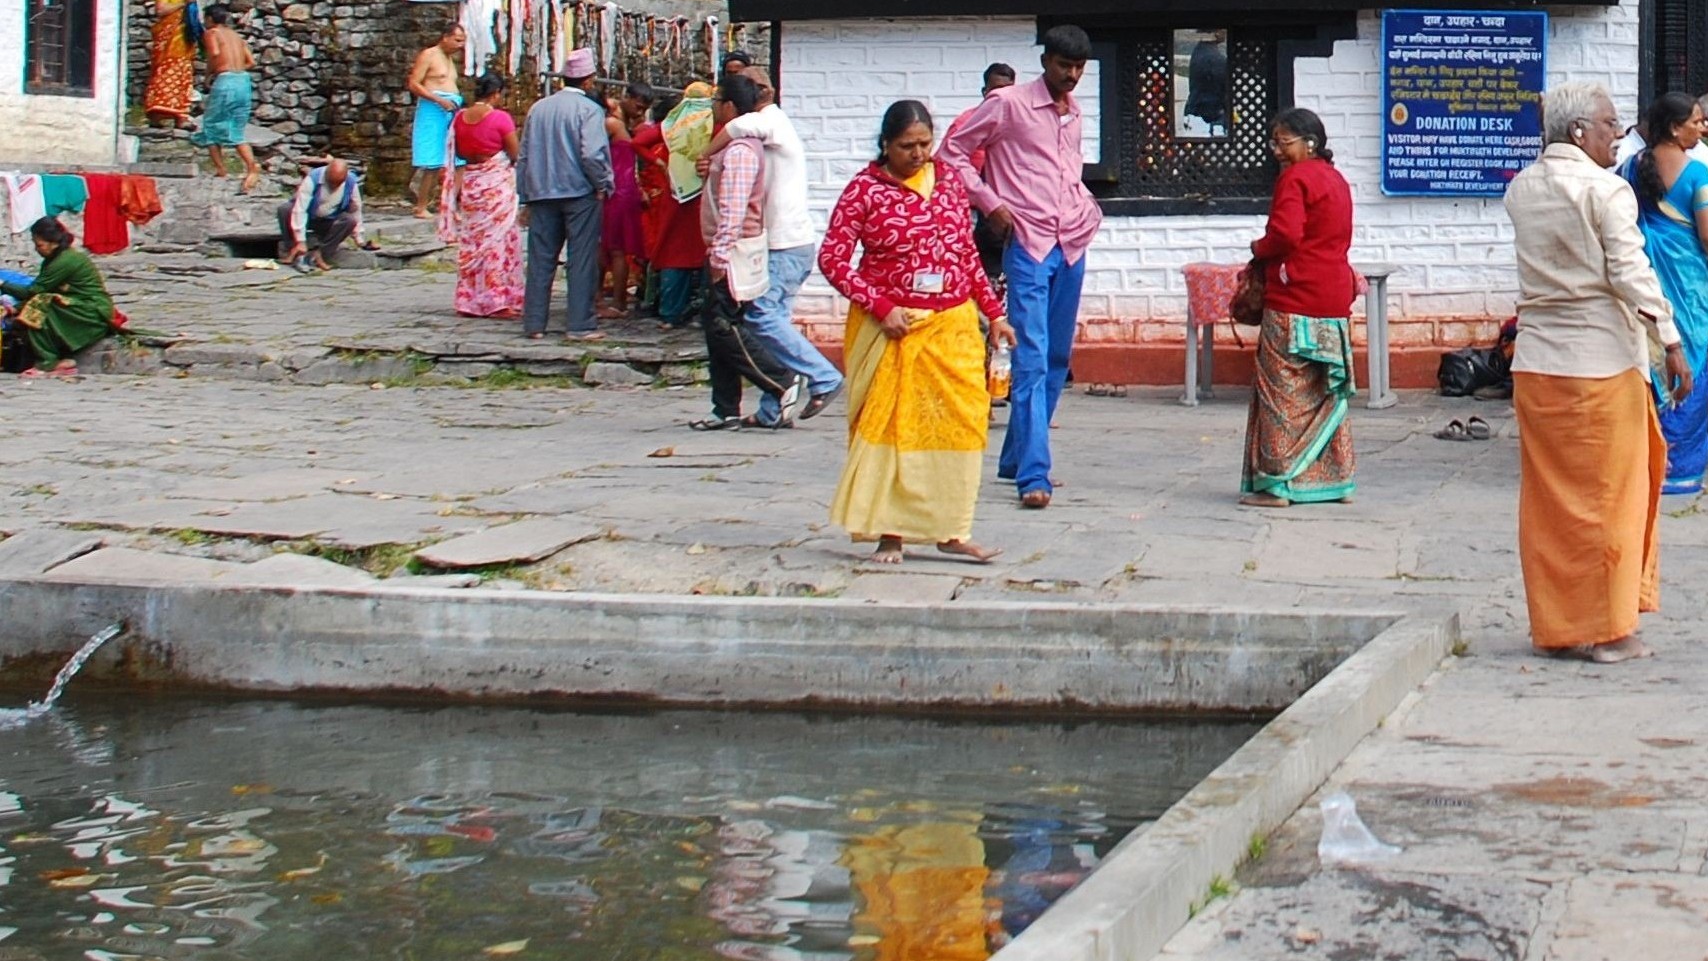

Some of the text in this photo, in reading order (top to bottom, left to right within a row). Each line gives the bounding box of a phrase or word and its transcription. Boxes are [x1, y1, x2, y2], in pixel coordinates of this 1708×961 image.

[1416, 116, 1513, 131] DONATION DESK
[1388, 133, 1421, 144] VISITOR
[1388, 169, 1409, 178] YOUR
